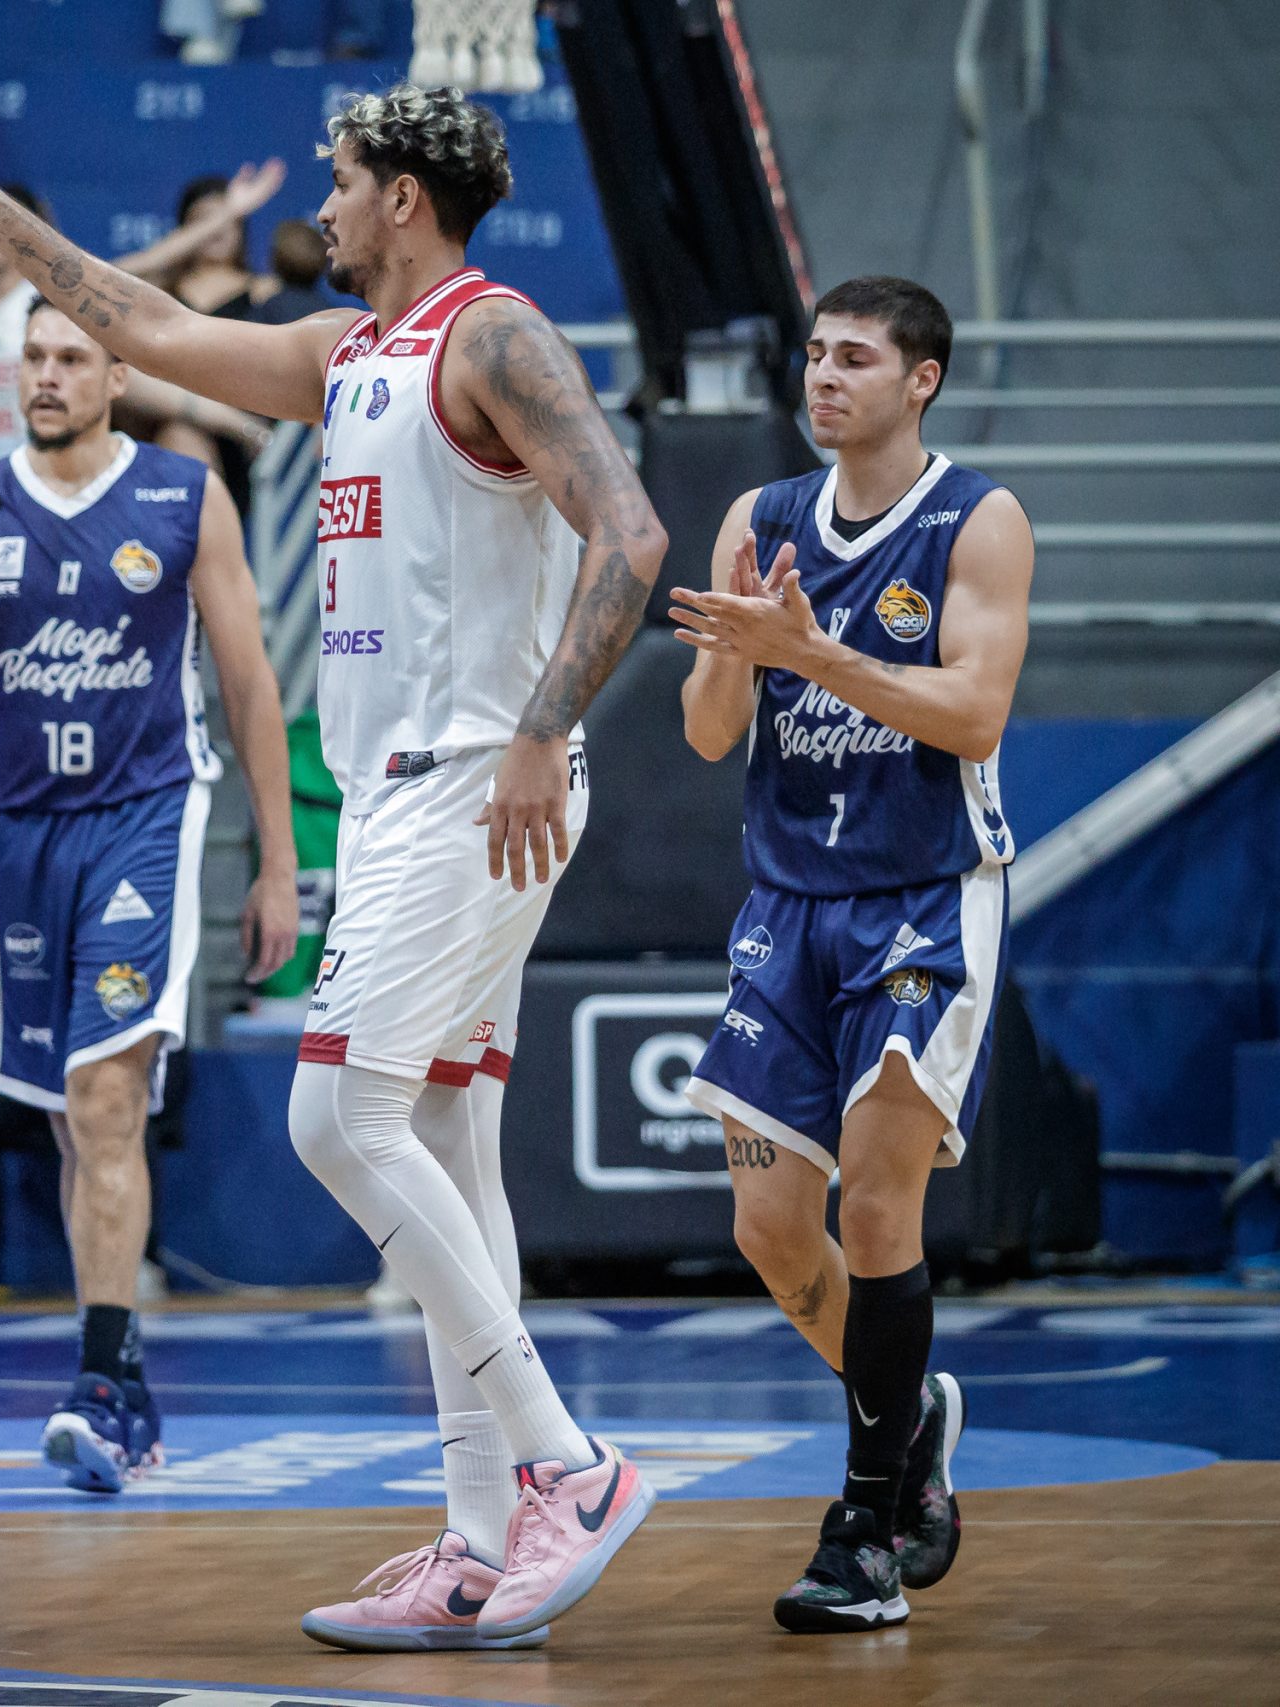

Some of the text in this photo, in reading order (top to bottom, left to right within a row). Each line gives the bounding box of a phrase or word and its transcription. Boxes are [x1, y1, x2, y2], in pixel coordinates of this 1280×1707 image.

[318, 484, 370, 538] SESI
[325, 556, 337, 614] 9
[21, 614, 132, 664] Mogi
[322, 629, 385, 656] SHOES
[42, 721, 95, 776] 18
[826, 793, 846, 847] 7
[729, 1136, 777, 1169] 2003
